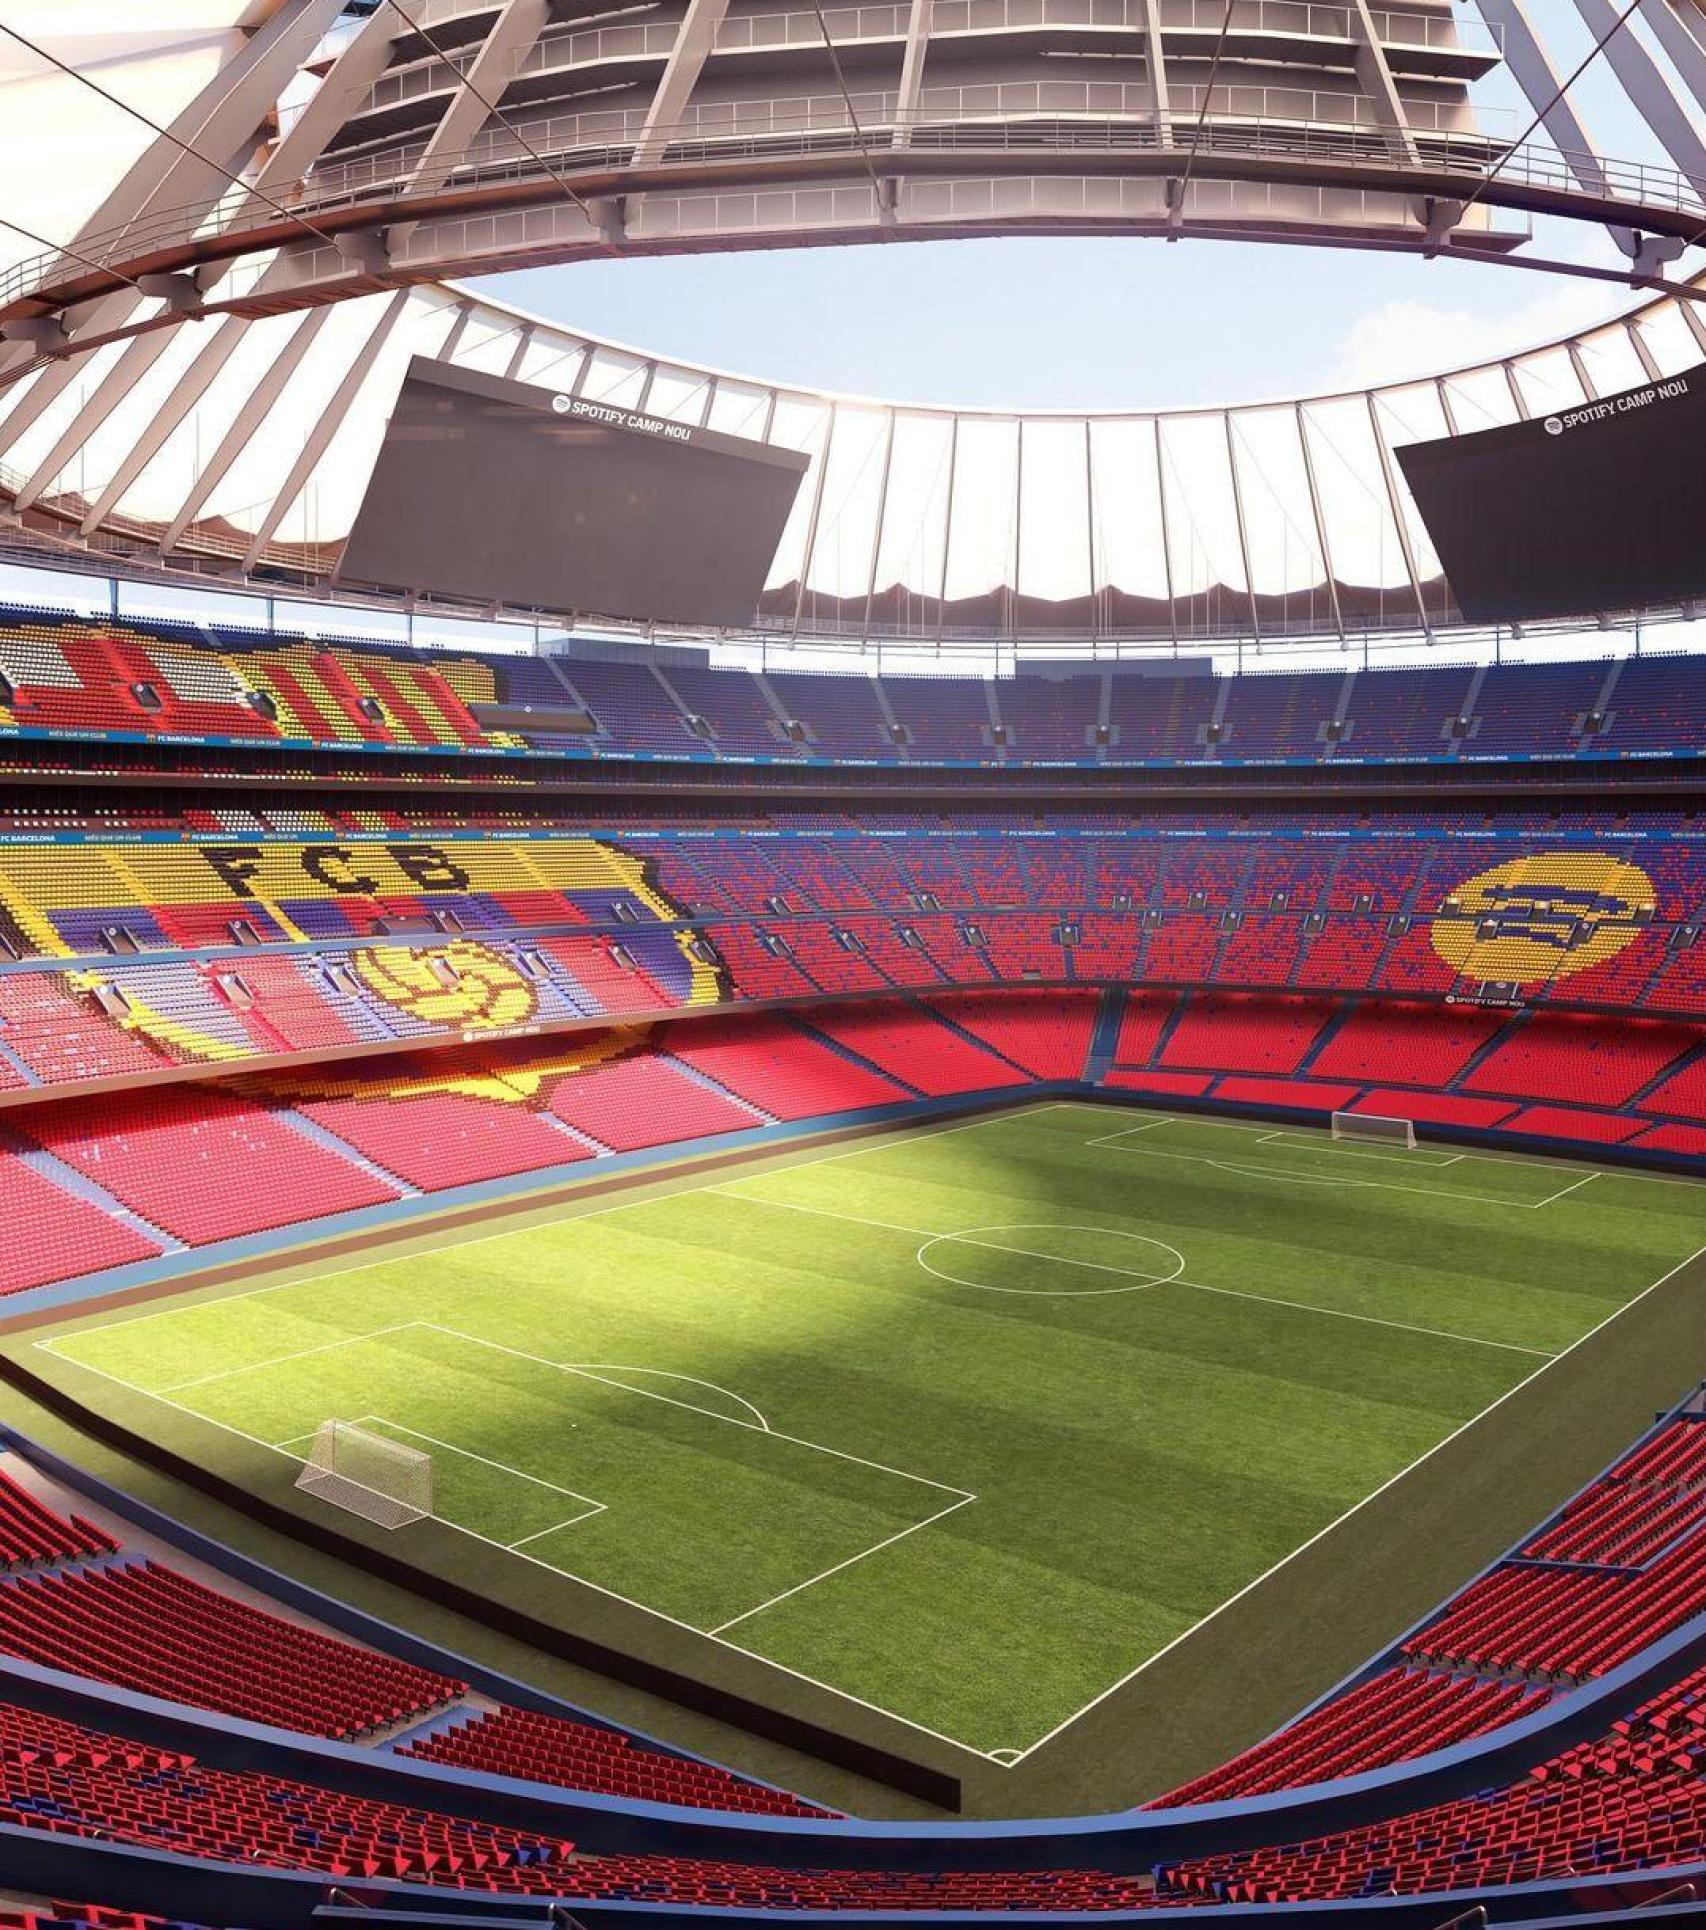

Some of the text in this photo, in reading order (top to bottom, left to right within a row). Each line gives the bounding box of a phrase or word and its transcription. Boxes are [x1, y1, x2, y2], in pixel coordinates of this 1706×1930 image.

[572, 401, 691, 441] SPOTIFY CAMP NOU
[1563, 379, 1688, 428] SPOTIFY CAMP NOU
[1456, 997, 1485, 1005] SPOTIFY
[1509, 1000, 1525, 1008] NOU
